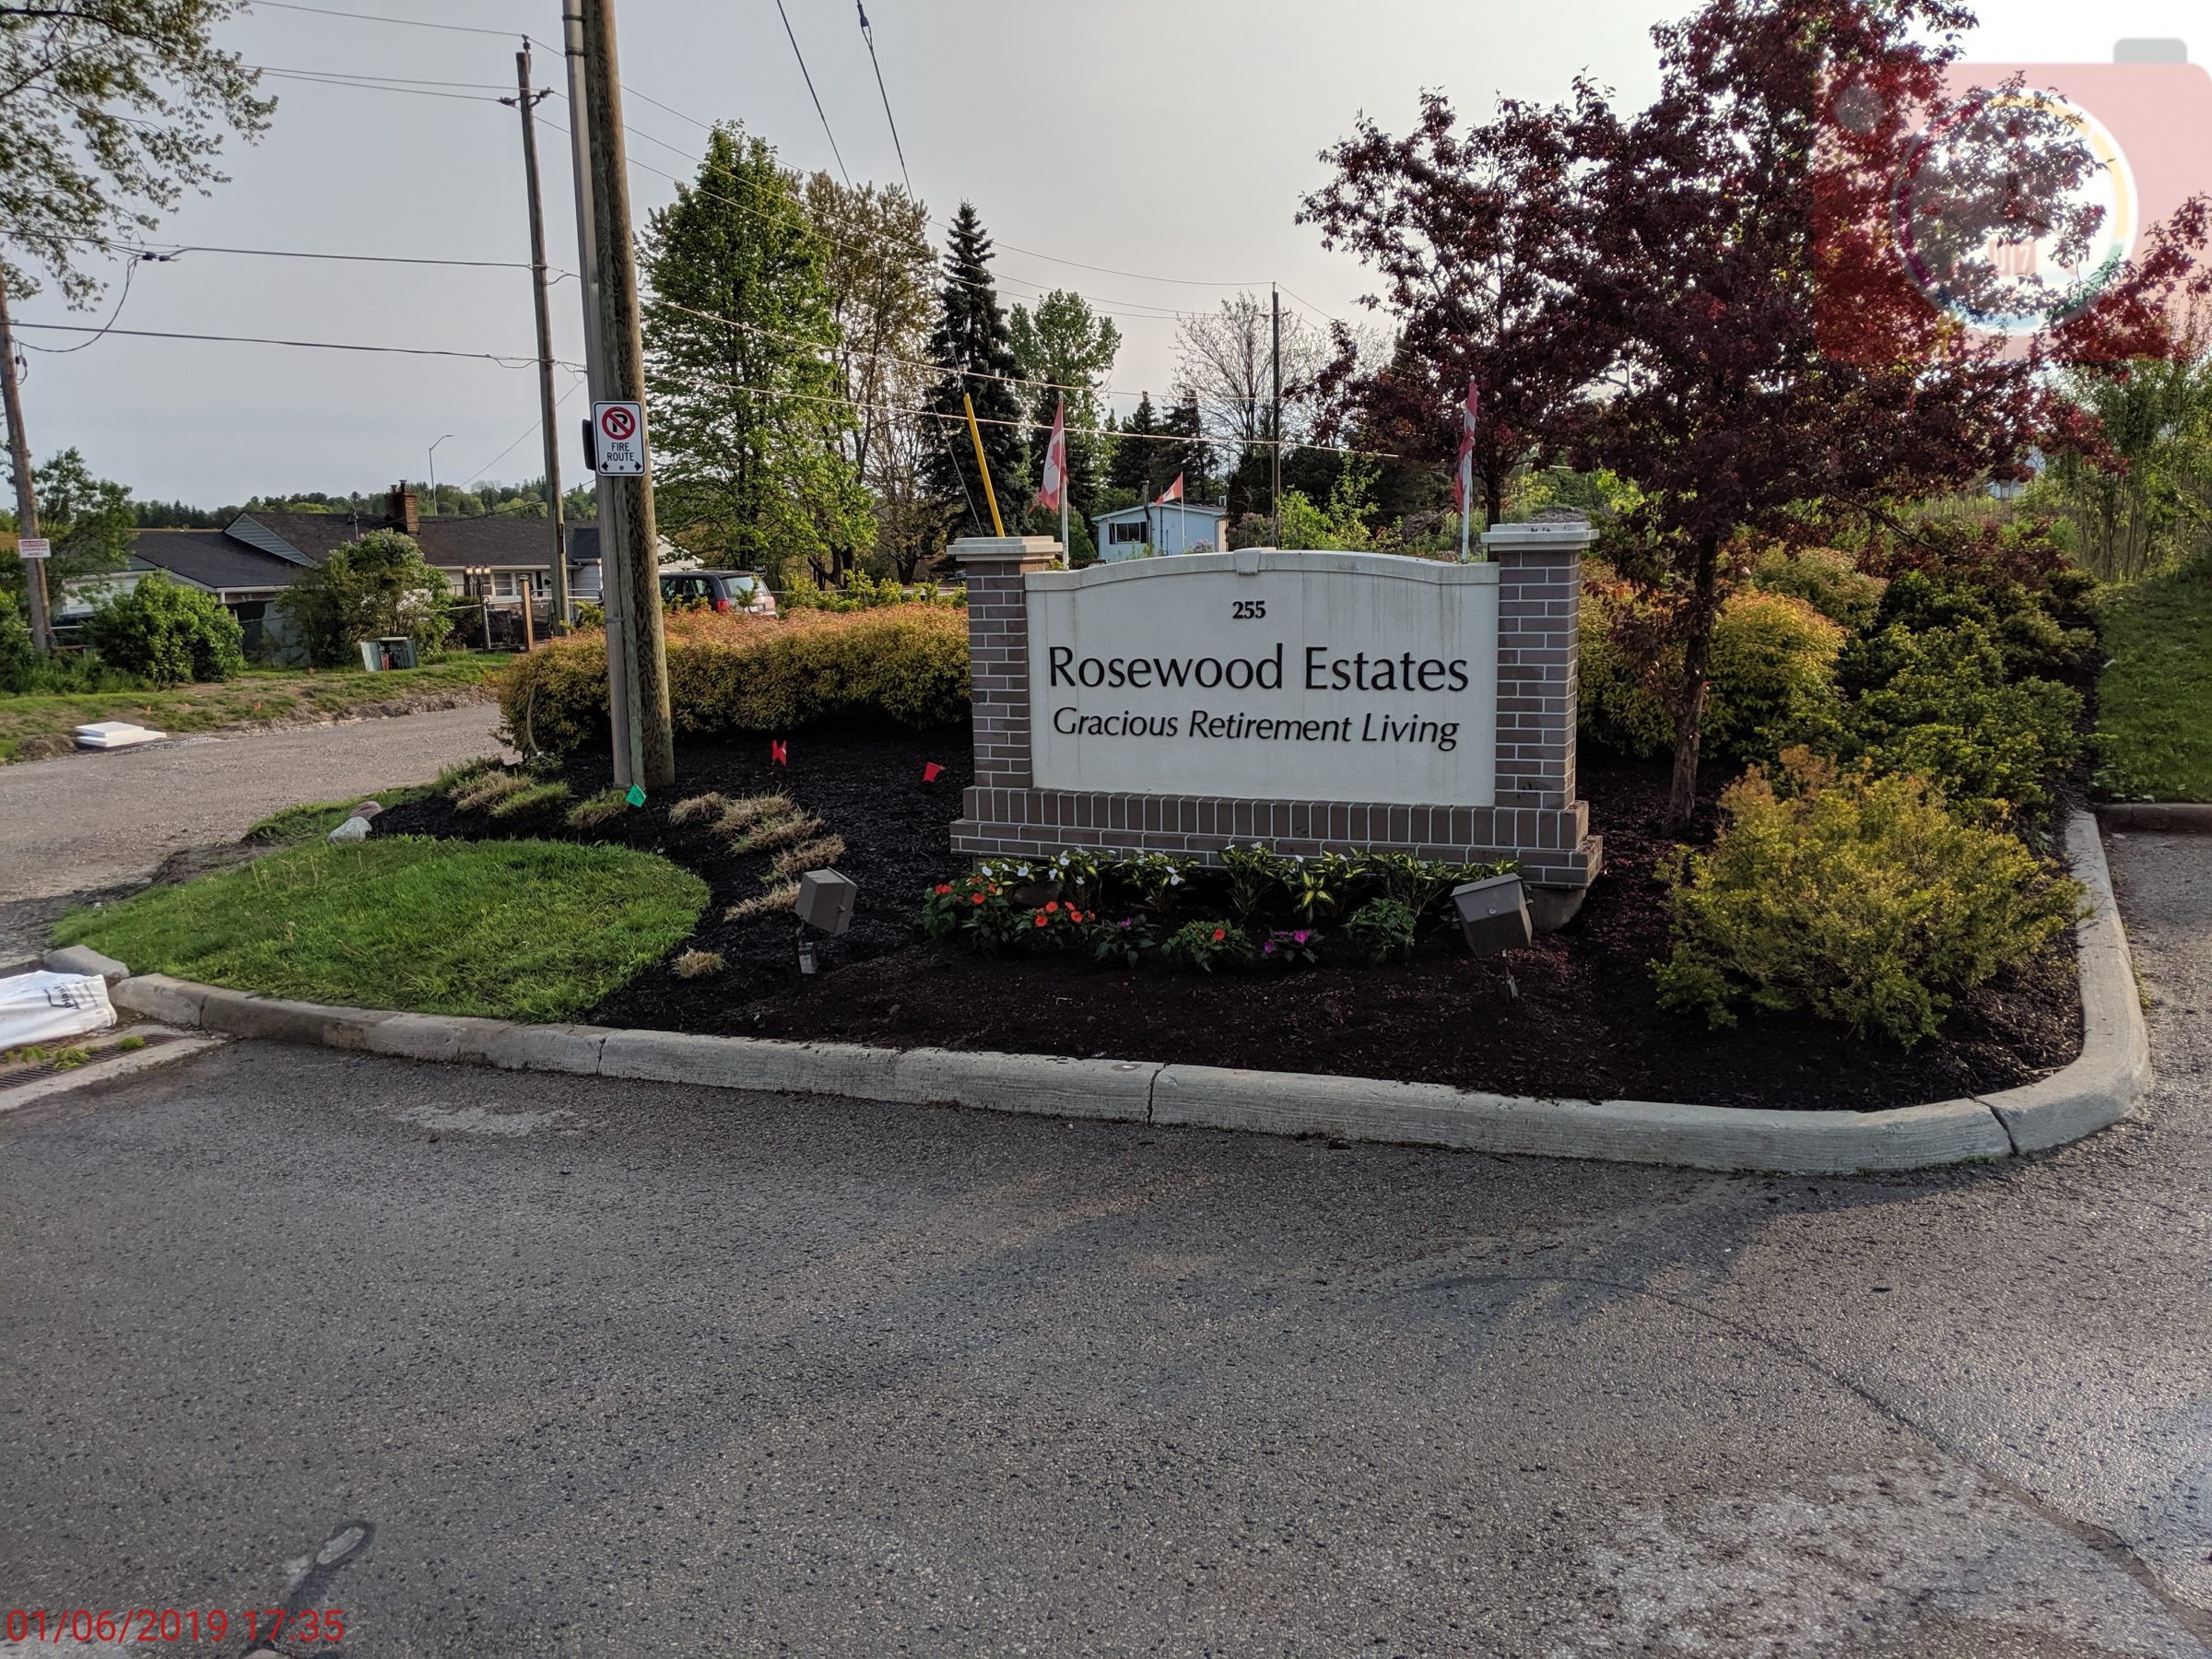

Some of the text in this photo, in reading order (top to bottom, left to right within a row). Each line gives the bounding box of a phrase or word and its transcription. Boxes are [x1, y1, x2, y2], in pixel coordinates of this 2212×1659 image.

[611, 442, 630, 452] FIRE
[606, 453, 635, 462] ROUTE
[1231, 600, 1266, 619] 255
[1049, 642, 1469, 692] Rosewood Estates
[1053, 706, 1460, 752] Gracious Retirement Living
